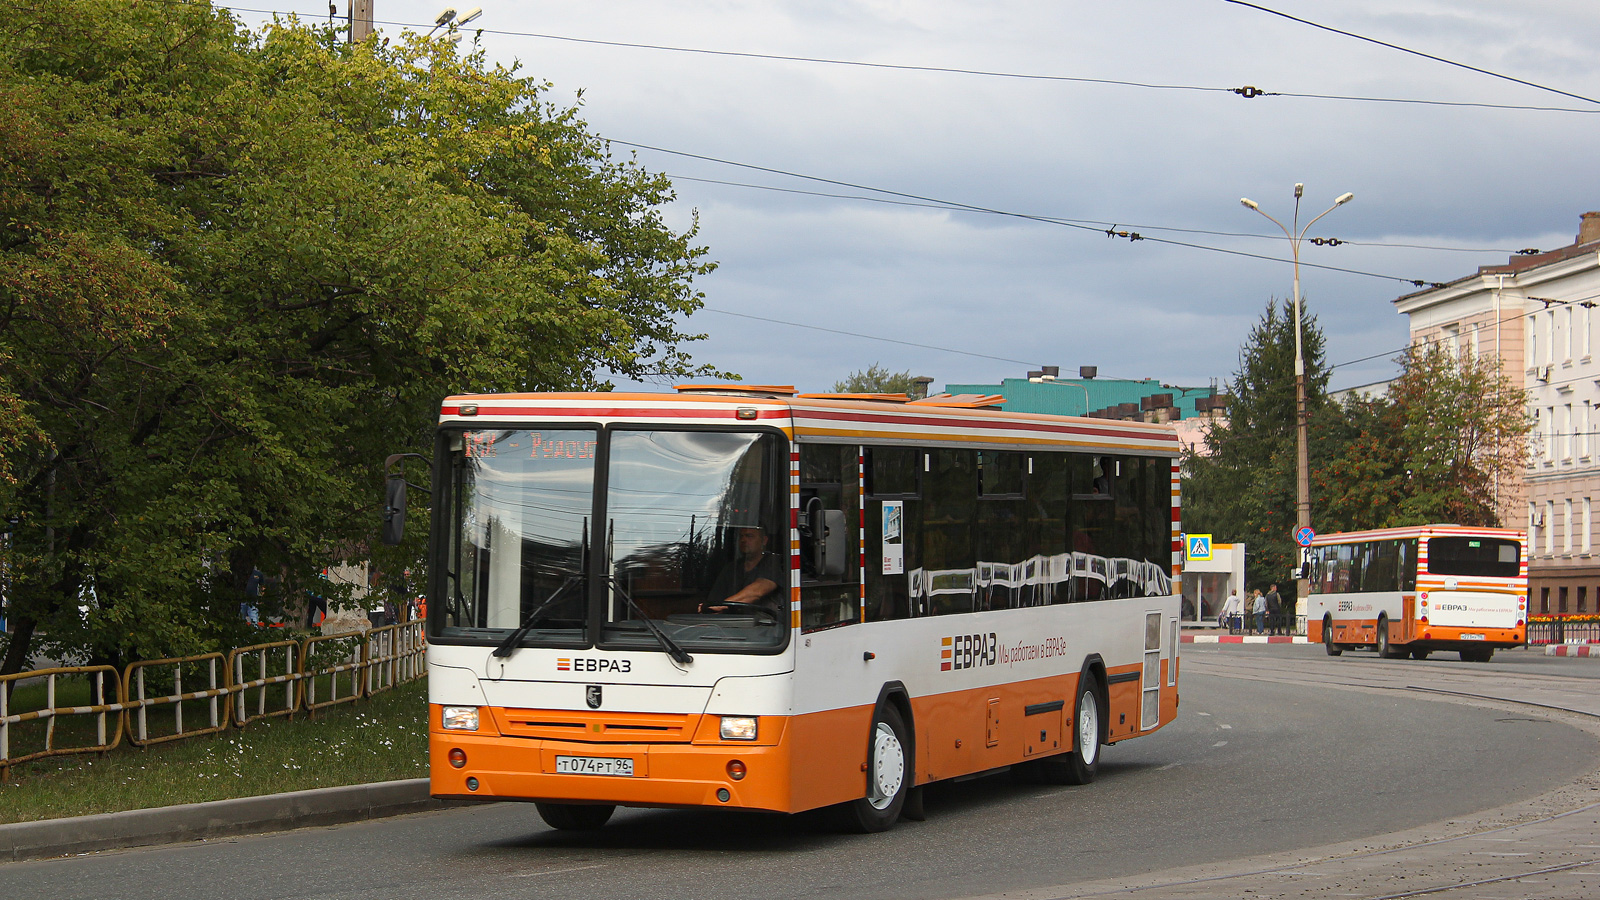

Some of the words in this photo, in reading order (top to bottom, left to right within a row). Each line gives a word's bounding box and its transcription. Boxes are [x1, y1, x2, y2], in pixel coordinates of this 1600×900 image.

[1442, 604, 1468, 612] ЕВРАЗ
[953, 632, 997, 671] ЕВРАЗ
[998, 644, 1009, 665] Мы
[1010, 640, 1040, 669] работаем
[1040, 643, 1045, 659] в
[1045, 636, 1067, 658] ЕВРАЗе
[574, 658, 632, 673] ЕВРАЗ
